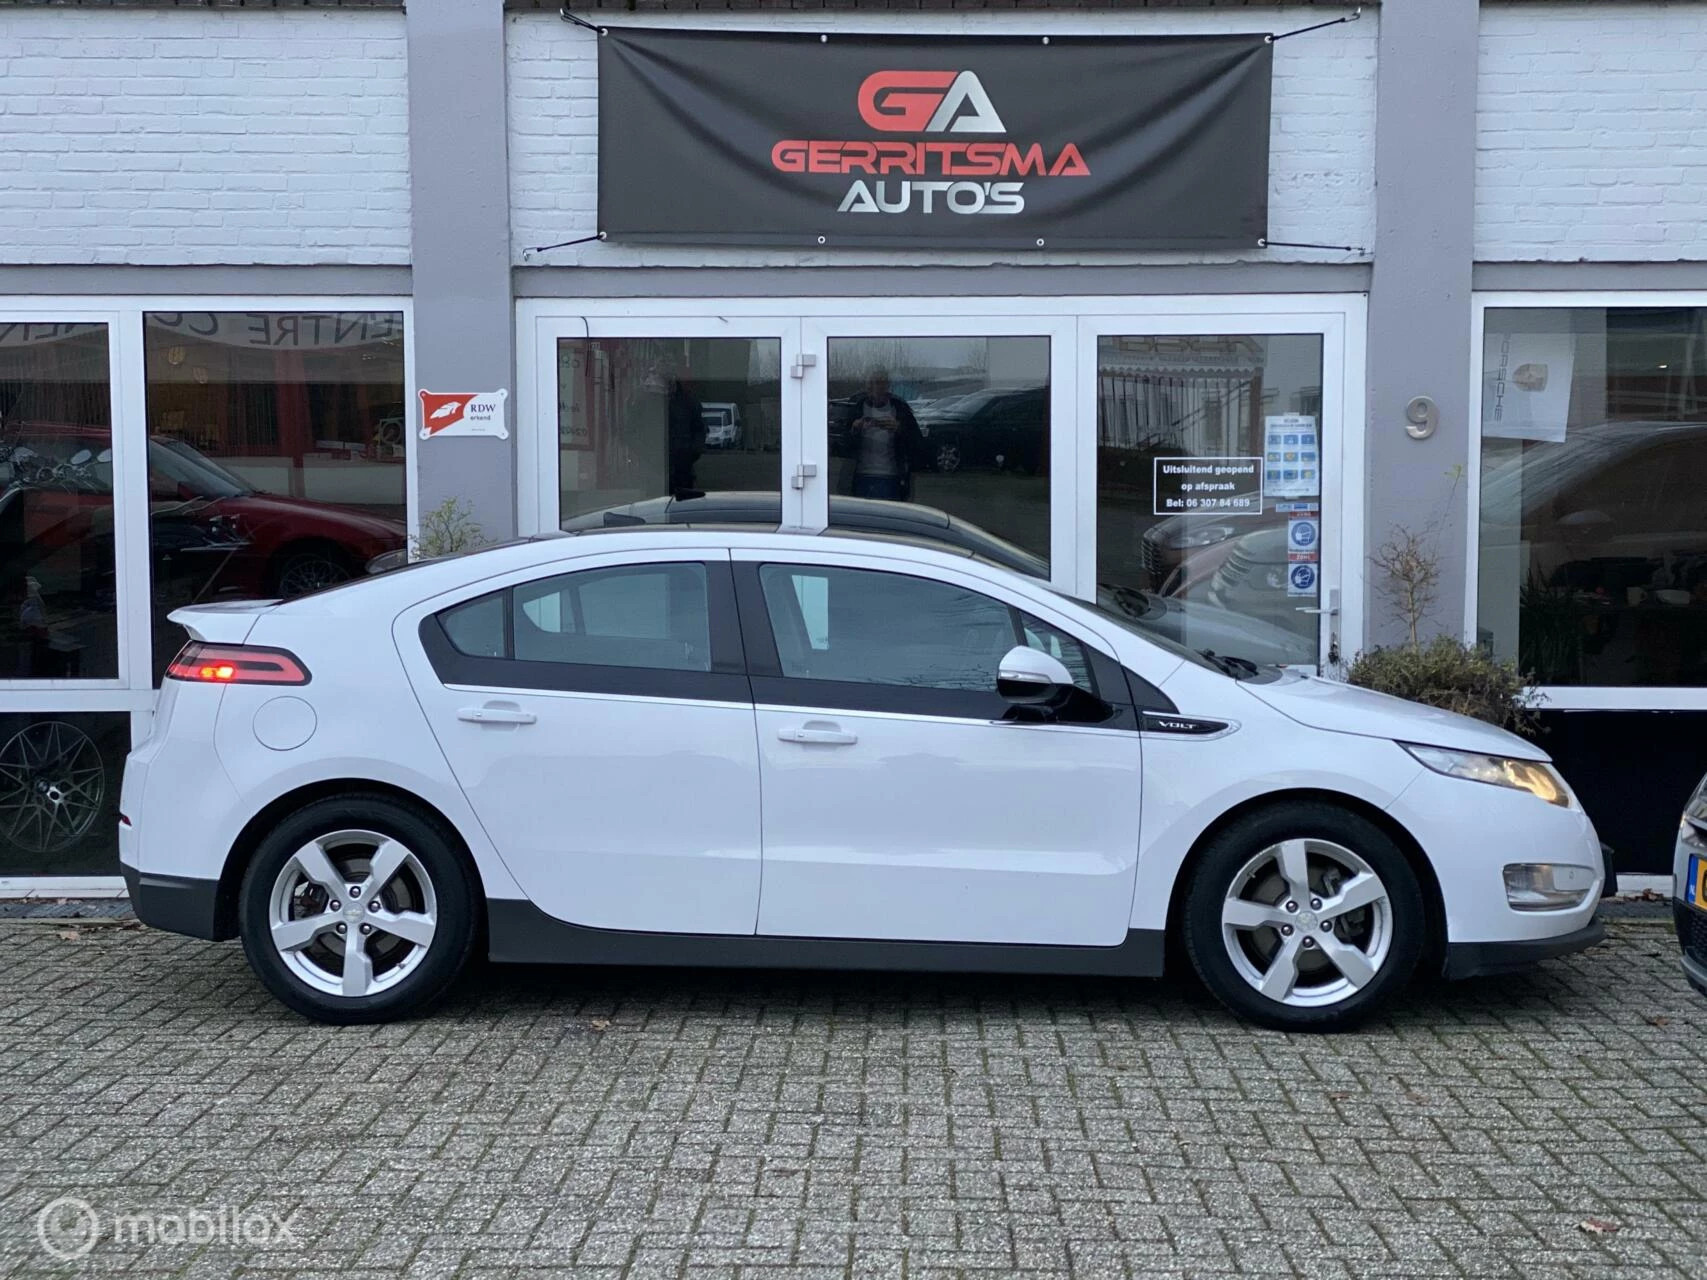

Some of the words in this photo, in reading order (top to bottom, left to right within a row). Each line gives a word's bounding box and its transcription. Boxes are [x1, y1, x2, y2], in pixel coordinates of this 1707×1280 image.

[857, 70, 1007, 133] GA
[771, 140, 1091, 177] GERRITSMA
[837, 179, 1025, 215] AUTO'S
[470, 404, 496, 413] RDW
[1405, 396, 1438, 440] 9
[1163, 465, 1213, 474] Uitsluitend
[1215, 465, 1254, 475] geopend
[1181, 483, 1193, 492] op
[1195, 482, 1235, 492] afspraak
[1166, 499, 1184, 508] Bel:
[1186, 499, 1198, 507] 06
[1200, 499, 1217, 507] 307
[1159, 720, 1197, 729] VOLT
